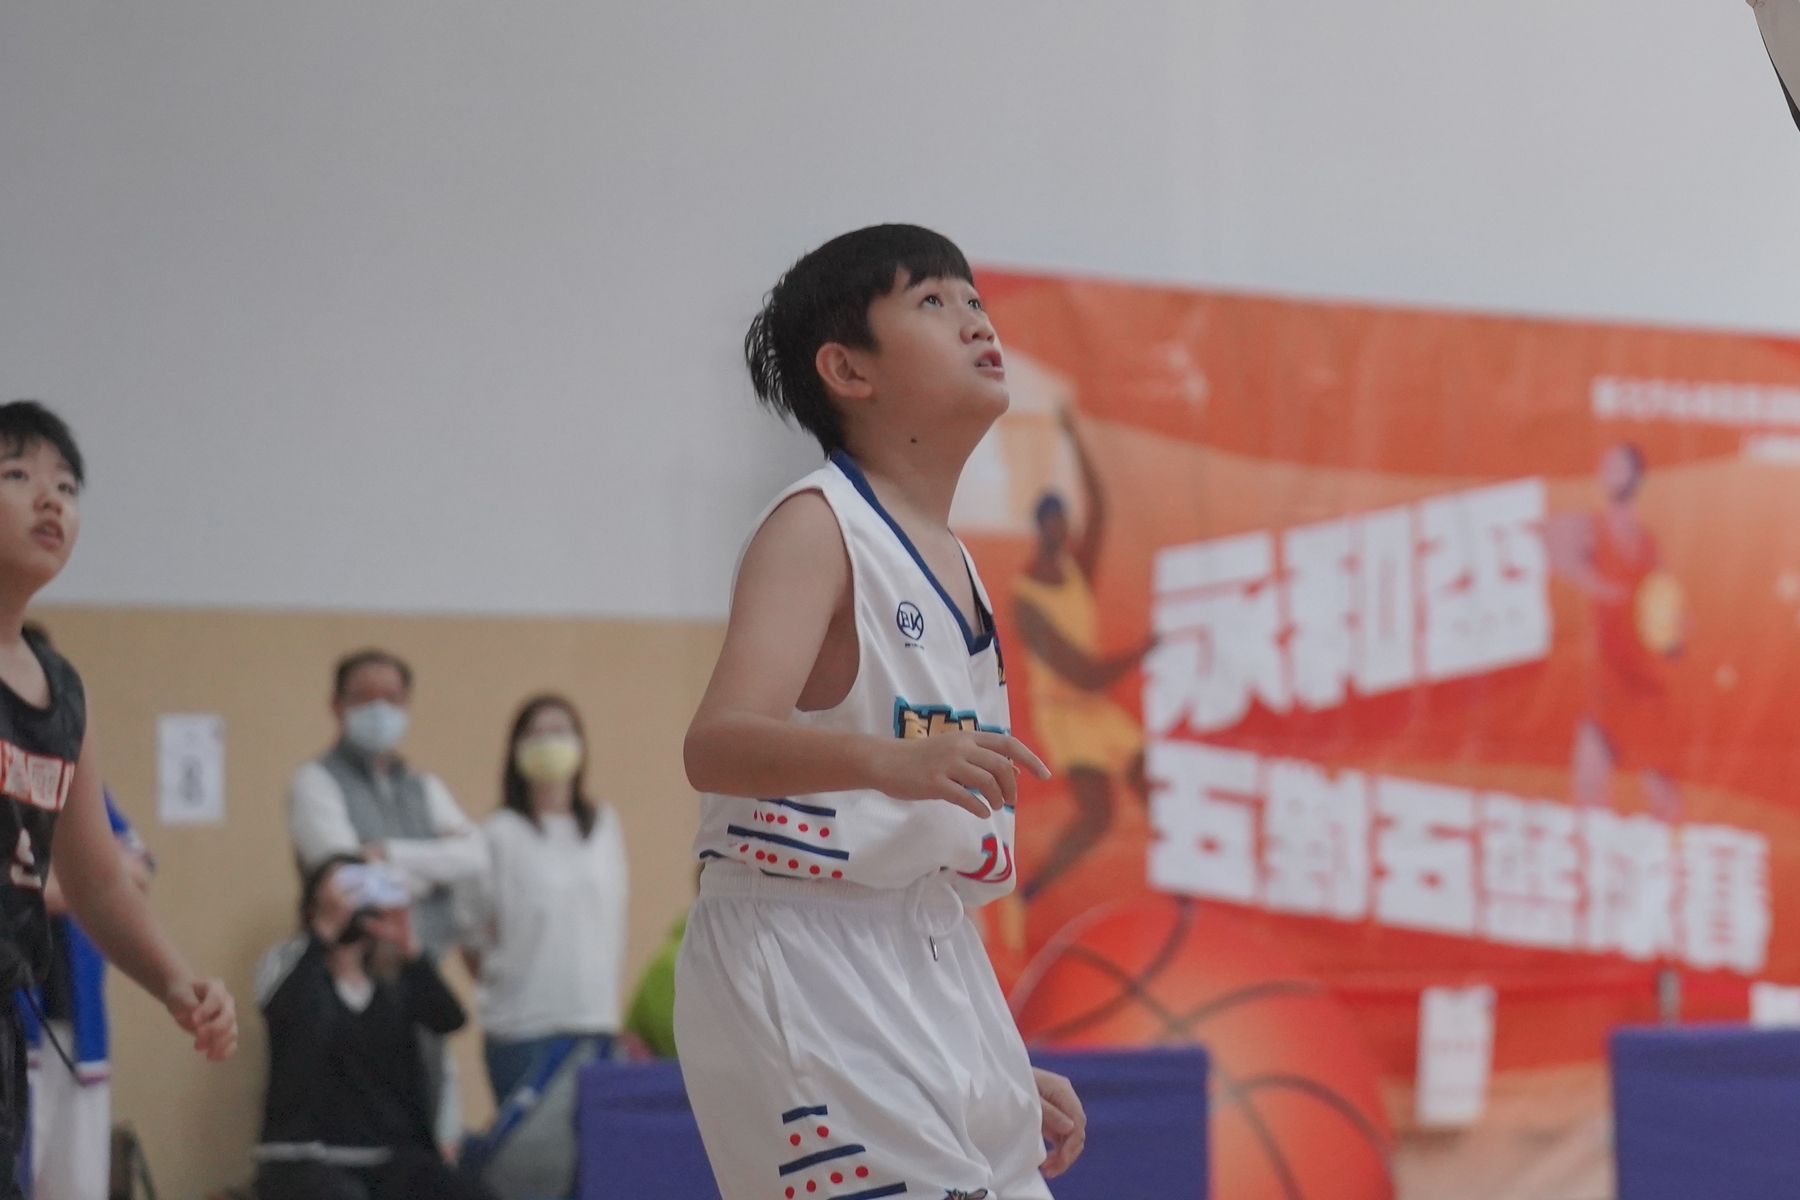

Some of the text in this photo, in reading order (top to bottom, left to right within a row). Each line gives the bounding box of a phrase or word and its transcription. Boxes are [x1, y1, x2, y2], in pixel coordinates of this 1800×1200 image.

[1141, 476, 1552, 735] 永和盃
[1147, 739, 1772, 973] 五對五籃球賽
